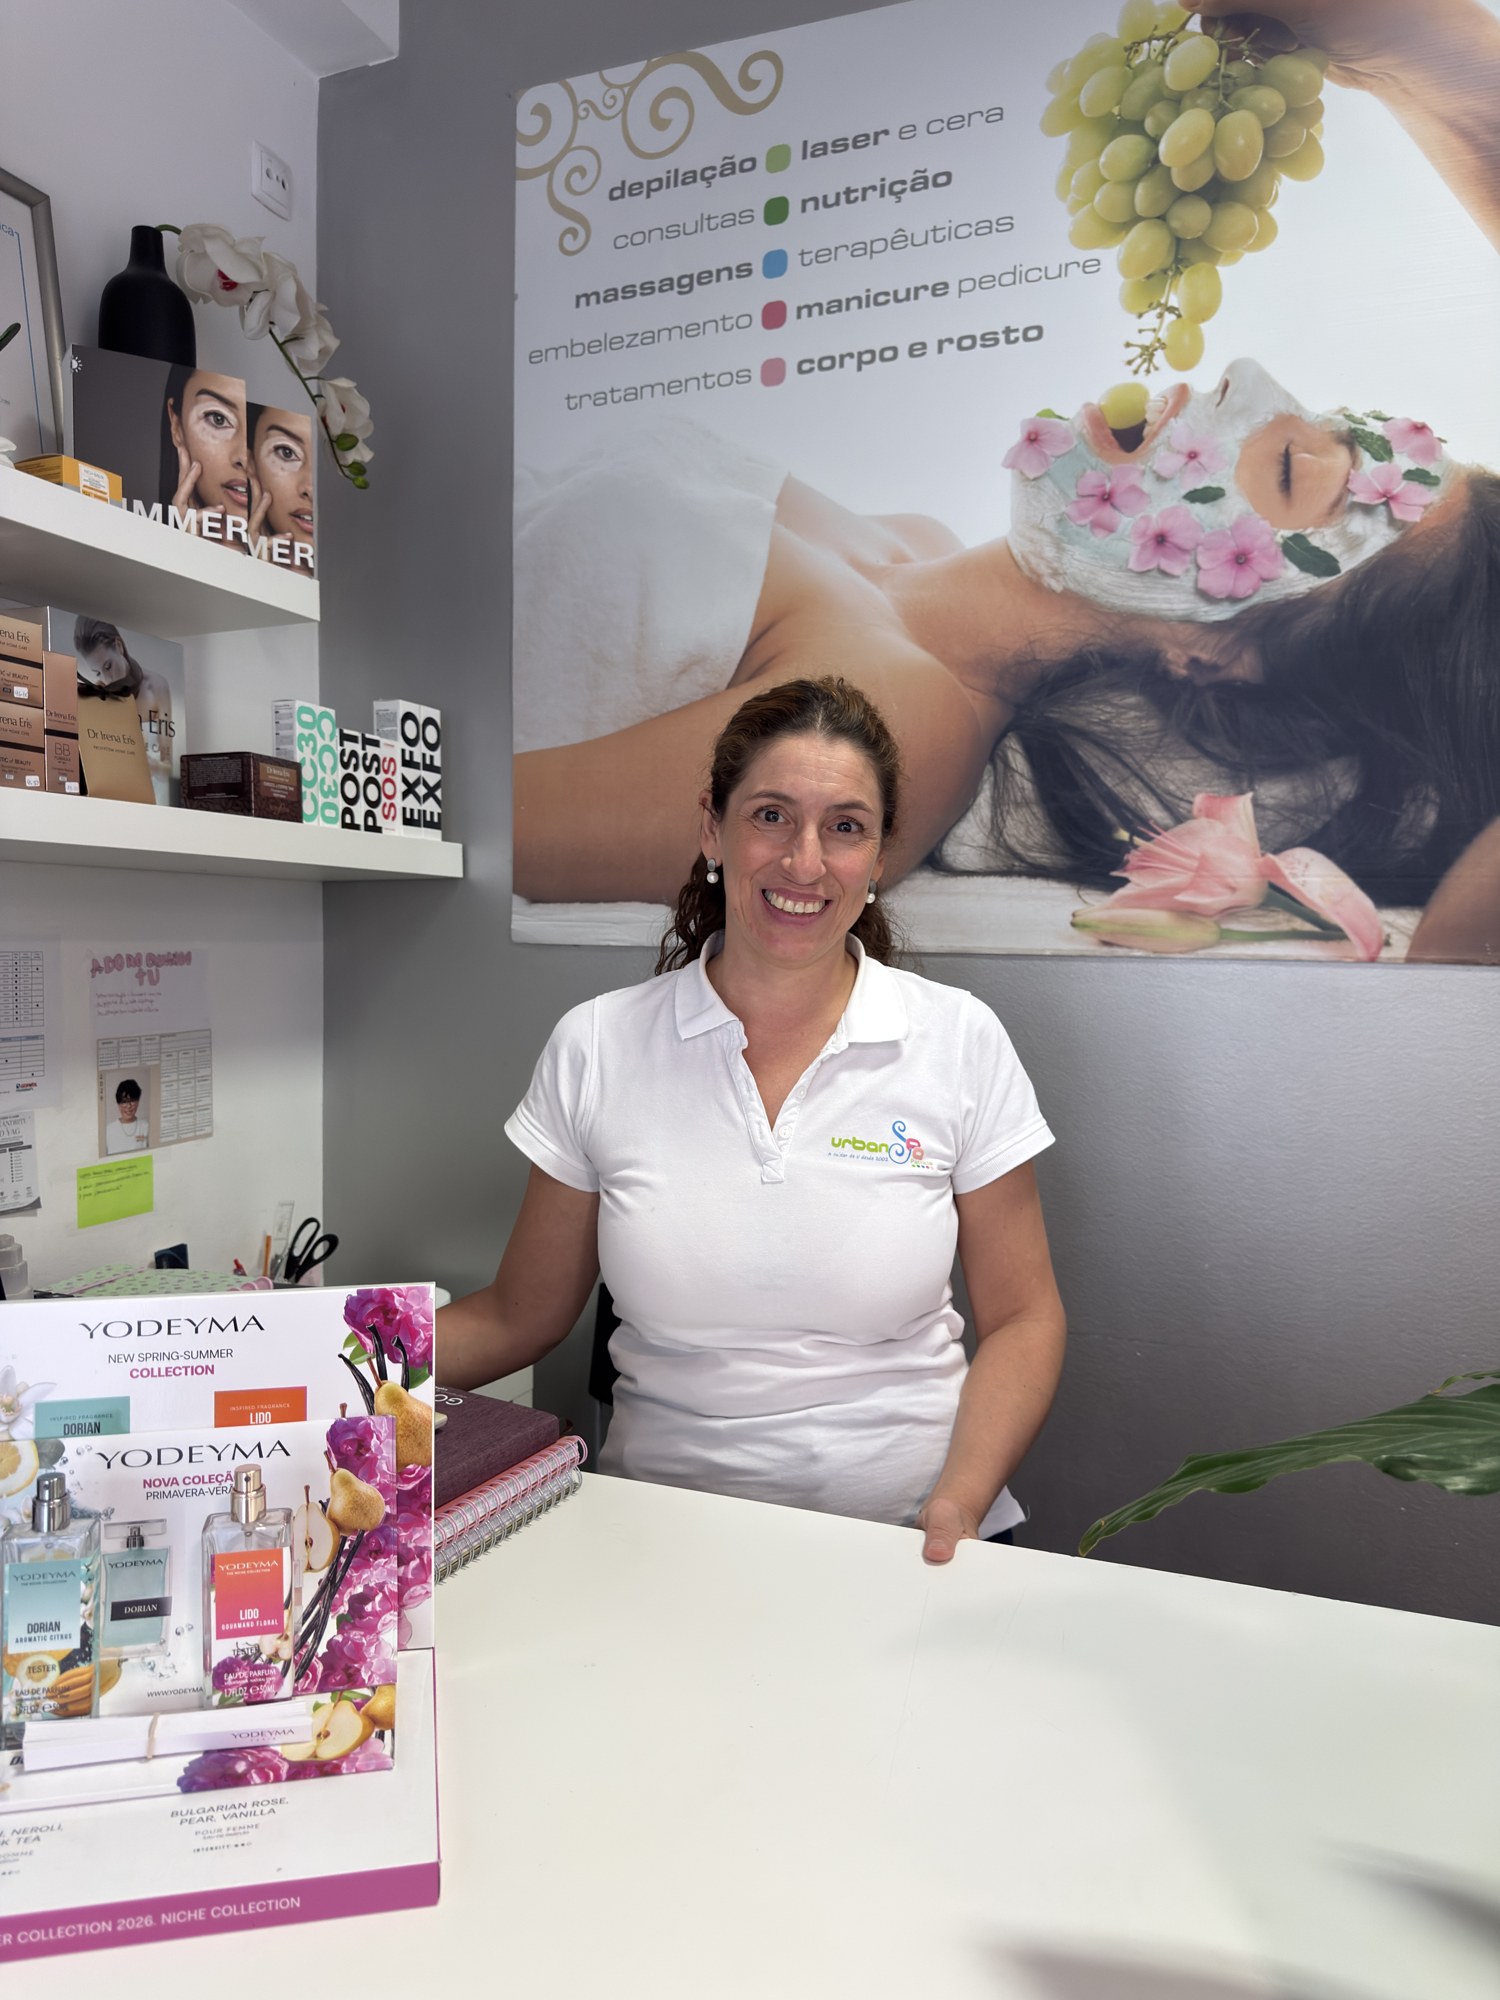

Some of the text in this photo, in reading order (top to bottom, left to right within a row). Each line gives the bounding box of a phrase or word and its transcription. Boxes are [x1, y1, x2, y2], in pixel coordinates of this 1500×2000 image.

[801, 106, 1004, 160] laser e cera
[608, 154, 757, 202] depilação
[801, 168, 953, 214] nutrição
[613, 208, 755, 250] consultas
[798, 215, 1015, 267] terapêuticas
[574, 262, 753, 309] massagens
[796, 257, 1101, 320] manicure pedicure
[528, 313, 753, 364] embelezamento
[796, 324, 1044, 375] corpo e rosto
[565, 368, 753, 410] tratamentos
[16, 630, 30, 644] Eris
[19, 717, 32, 729] Eris
[149, 709, 176, 738] Eris
[87, 728, 136, 746] Dr Irena Eris
[54, 742, 70, 756] BB
[401, 711, 422, 828] EXFO
[421, 716, 442, 831] EXFO
[339, 728, 361, 831] POST
[361, 733, 383, 834] POST
[382, 756, 397, 822] SOS
[79, 1315, 265, 1339] YODEYMA
[108, 1348, 234, 1364] NEW SPRING-SUMMER
[129, 1364, 215, 1379] COLLECTION
[250, 1411, 272, 1425] LIDO
[63, 1421, 101, 1436] DORIAN
[95, 1439, 292, 1470] YODEYMA
[142, 1470, 234, 1489] NOVA COLEÇÃ
[146, 1483, 233, 1501] PRIMAVERA-VERÃ
[108, 1558, 164, 1570] YODEYMA
[219, 1560, 279, 1572] YODEYMA
[14, 1570, 76, 1582] YODEYMA
[124, 1604, 158, 1614] DORIAN
[240, 1608, 259, 1620] LIDO
[27, 1621, 61, 1634] DORIAN
[221, 1618, 278, 1631] GOURMAND FLORAL
[15, 1632, 72, 1644] AROMATIC CITRUS
[27, 1664, 57, 1674] TESTER
[224, 1672, 238, 1680] EAU
[250, 1668, 276, 1678] PARFUM
[231, 1728, 295, 1740] YODEYMA
[170, 1802, 248, 1818] BULGARIAN
[222, 1807, 276, 1821] VANILLA
[194, 1823, 260, 1837] POUR FEMME
[16, 1834, 41, 1846] TEA
[16, 1920, 112, 1944] COLLECTION
[161, 1906, 207, 1926] NICHE
[210, 1896, 301, 1919] COLLECTION
